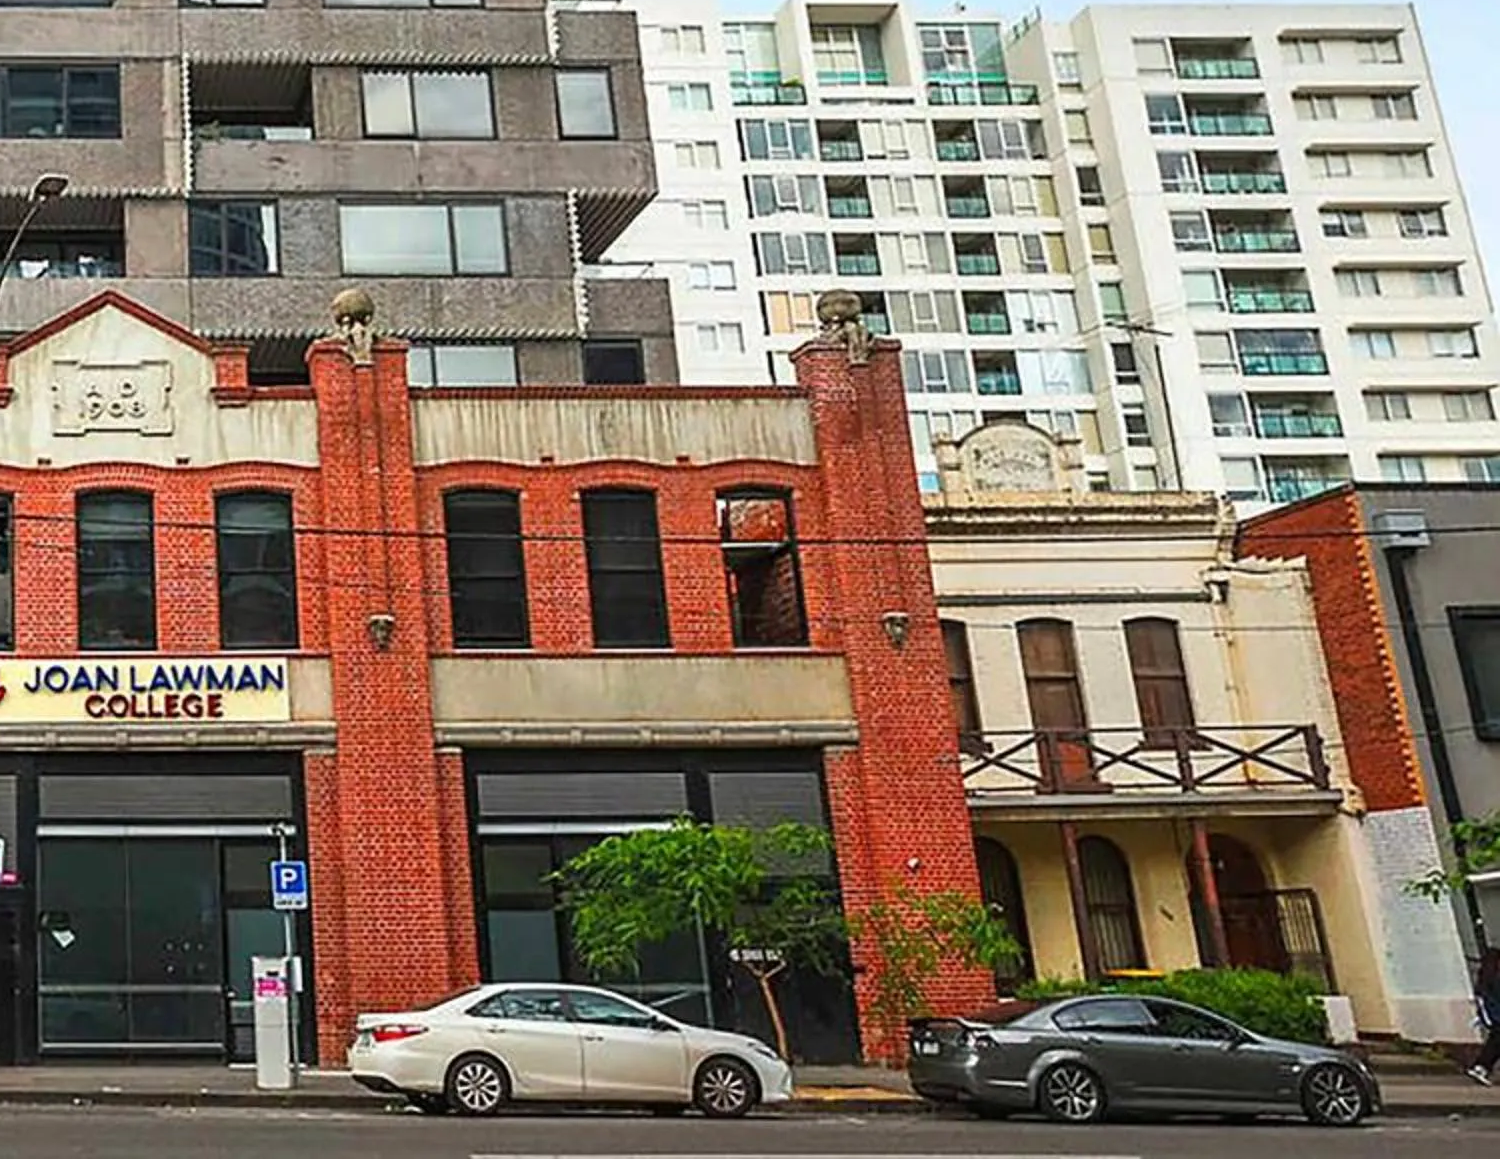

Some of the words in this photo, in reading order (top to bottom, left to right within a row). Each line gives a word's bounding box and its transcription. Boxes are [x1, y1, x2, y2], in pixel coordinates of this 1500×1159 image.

[23, 665, 119, 693] JOAN
[129, 664, 284, 692] LAWMAN
[84, 693, 225, 719] COLLEGE
[279, 867, 298, 890] P
